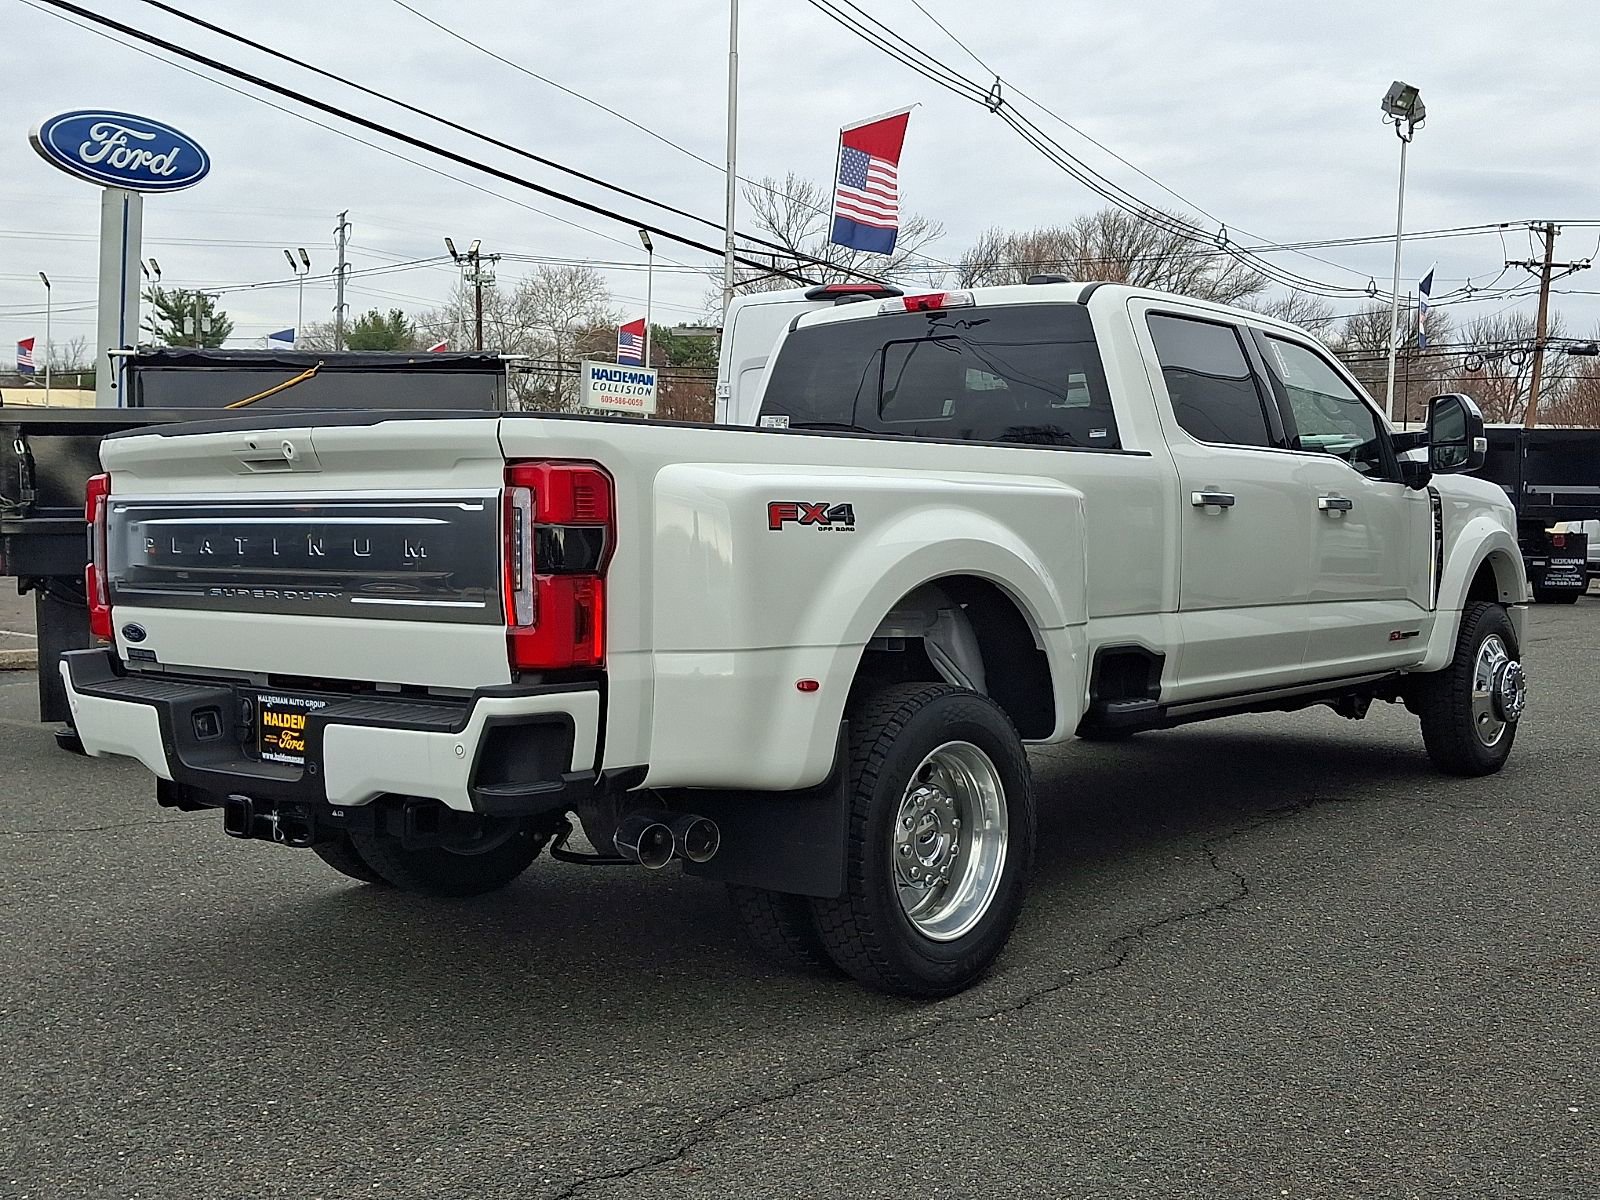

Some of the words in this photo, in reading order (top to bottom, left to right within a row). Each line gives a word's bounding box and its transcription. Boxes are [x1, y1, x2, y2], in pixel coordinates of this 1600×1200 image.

[80, 122, 180, 176] Ford
[591, 367, 655, 386] HALDEMAN
[592, 382, 652, 396] COLLISION
[768, 501, 855, 531] FX4
[143, 536, 427, 558] PLATINUM
[209, 587, 279, 599] SUPER
[283, 590, 343, 600] DUTY
[257, 694, 288, 705] HALDEMAN
[289, 697, 304, 707] AUTO
[305, 699, 326, 709] GROUP
[279, 730, 305, 751] Ford
